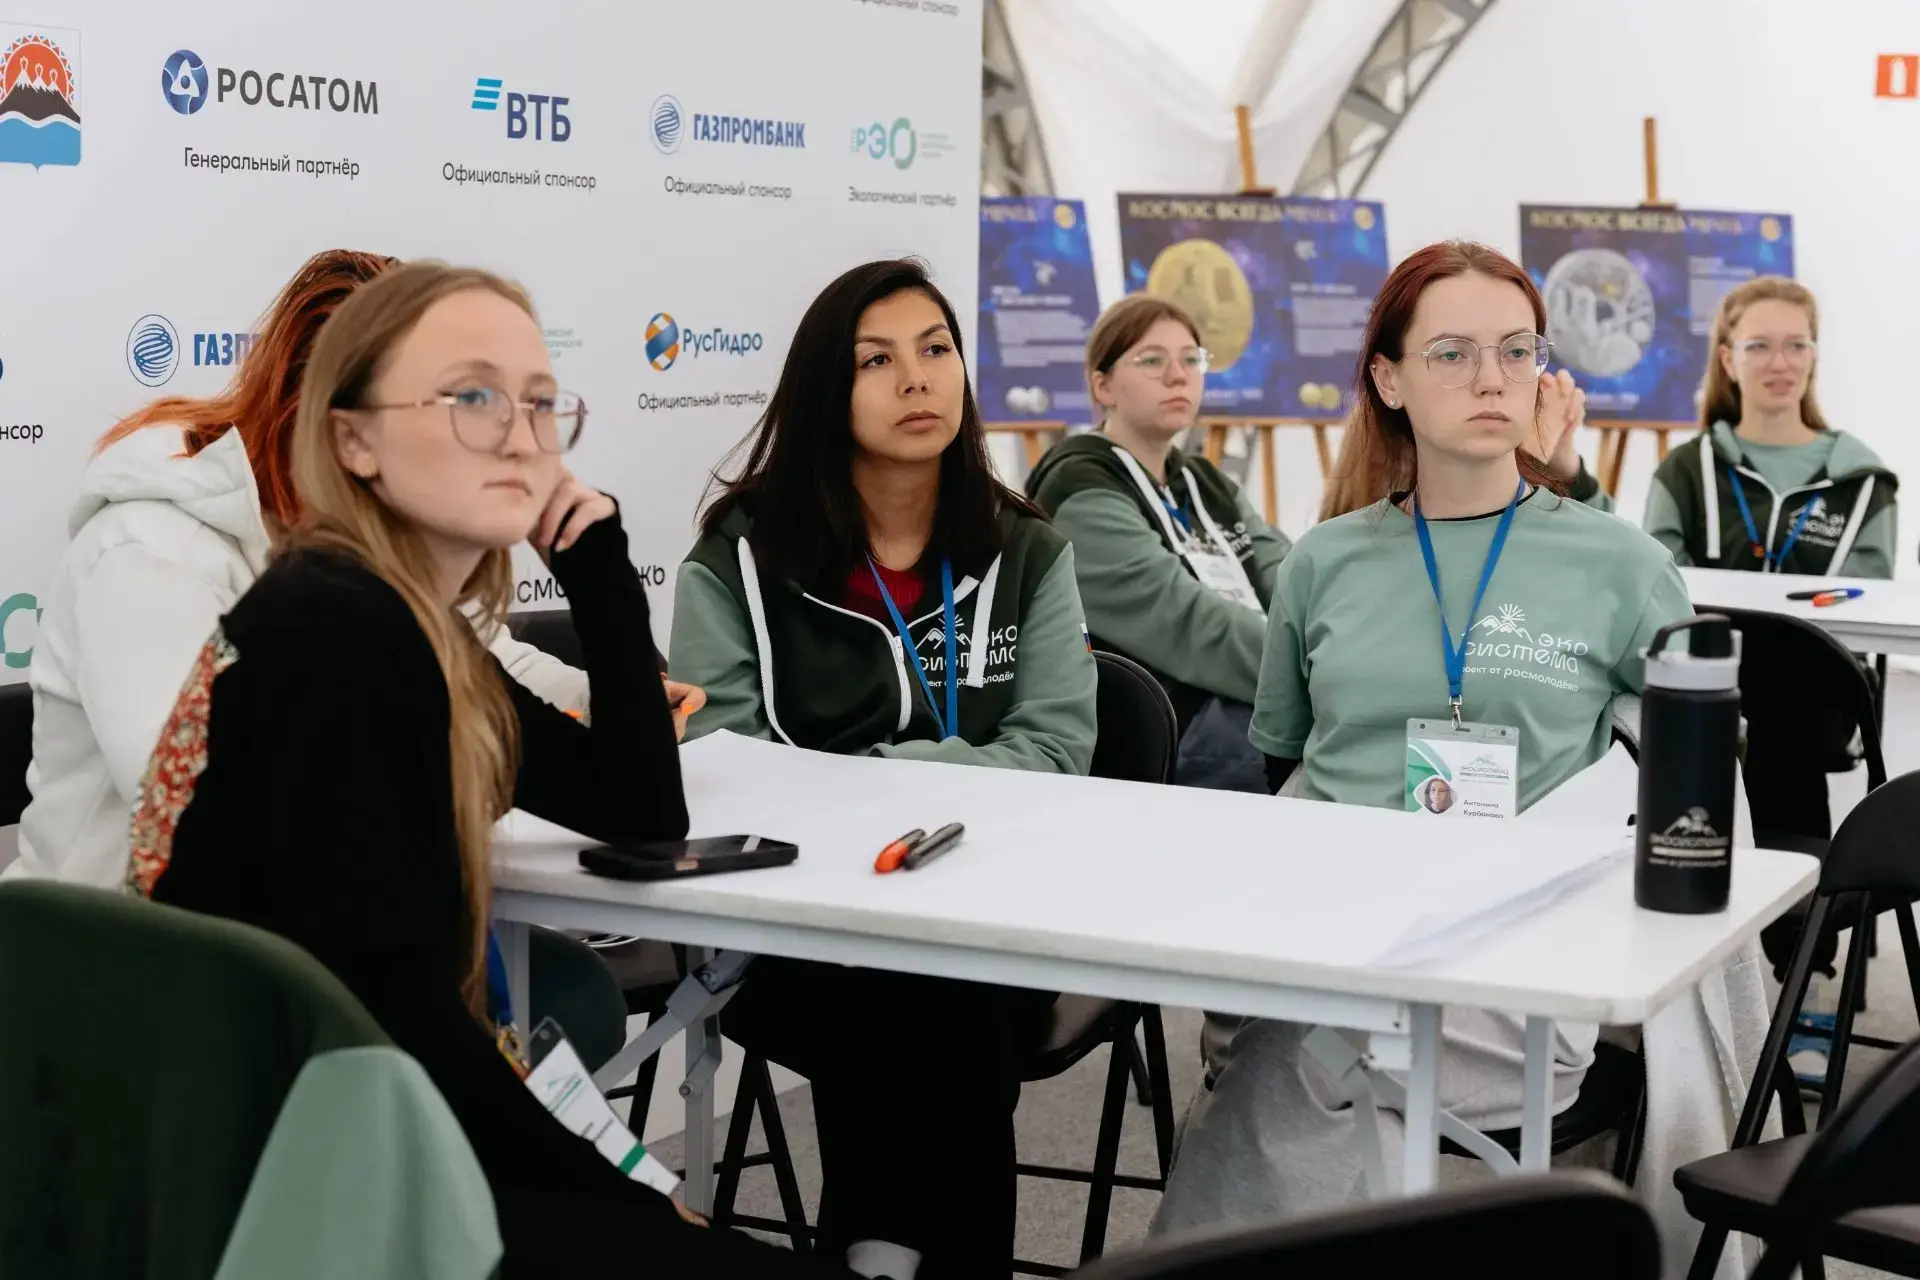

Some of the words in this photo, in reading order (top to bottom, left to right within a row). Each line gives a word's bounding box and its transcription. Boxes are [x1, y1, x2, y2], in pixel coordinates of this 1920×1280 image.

[217, 67, 379, 115] РОСАТОМ
[507, 92, 571, 142] ВТБ
[693, 113, 806, 148] ГАЗПРОМБАНК
[184, 147, 290, 174] Генеральный
[296, 158, 360, 180] партнёр
[442, 162, 541, 186] Официальный
[544, 173, 597, 194] спонсор
[664, 175, 745, 196] Официальный
[749, 184, 792, 200] спонсор
[682, 328, 763, 358] РусГидро
[638, 393, 720, 411] Официальный
[0, 424, 43, 444] нсор
